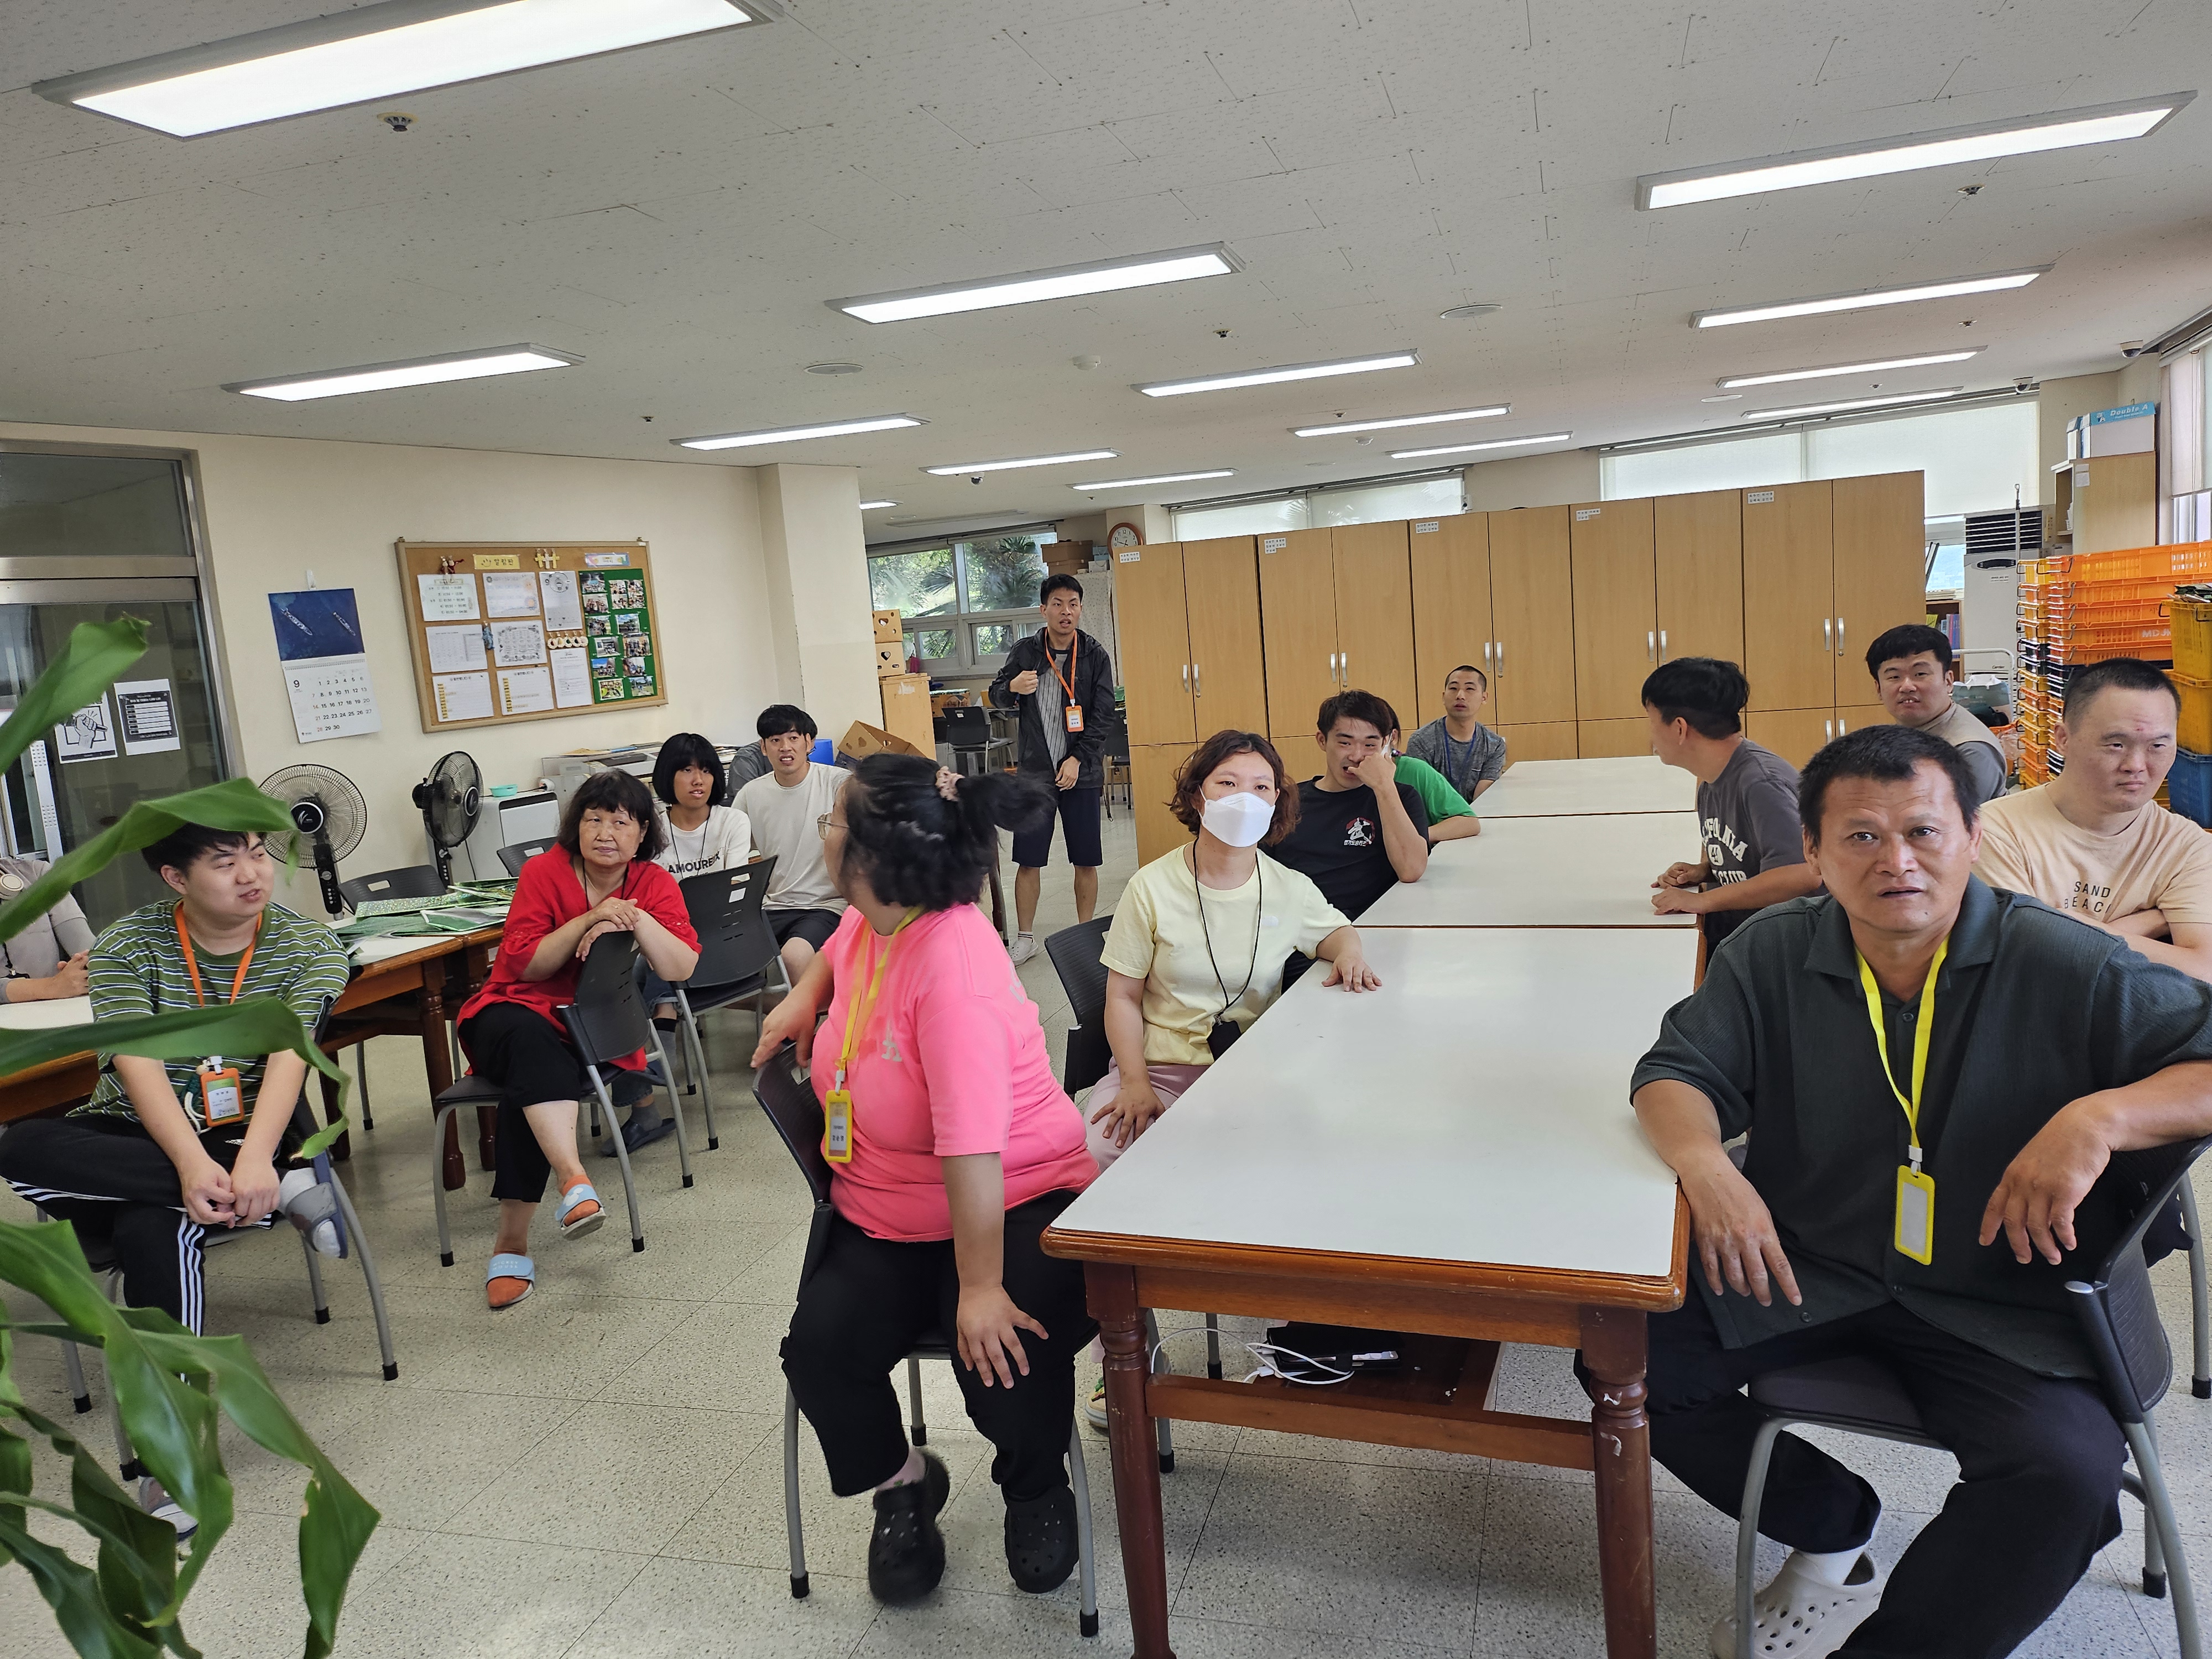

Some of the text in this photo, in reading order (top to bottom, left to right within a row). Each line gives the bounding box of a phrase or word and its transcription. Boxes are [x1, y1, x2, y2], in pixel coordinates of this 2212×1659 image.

[2110, 406, 2140, 416] Double
[293, 680, 300, 688] 9
[668, 851, 721, 874] AMOUREX
[2074, 881, 2111, 898] SAND
